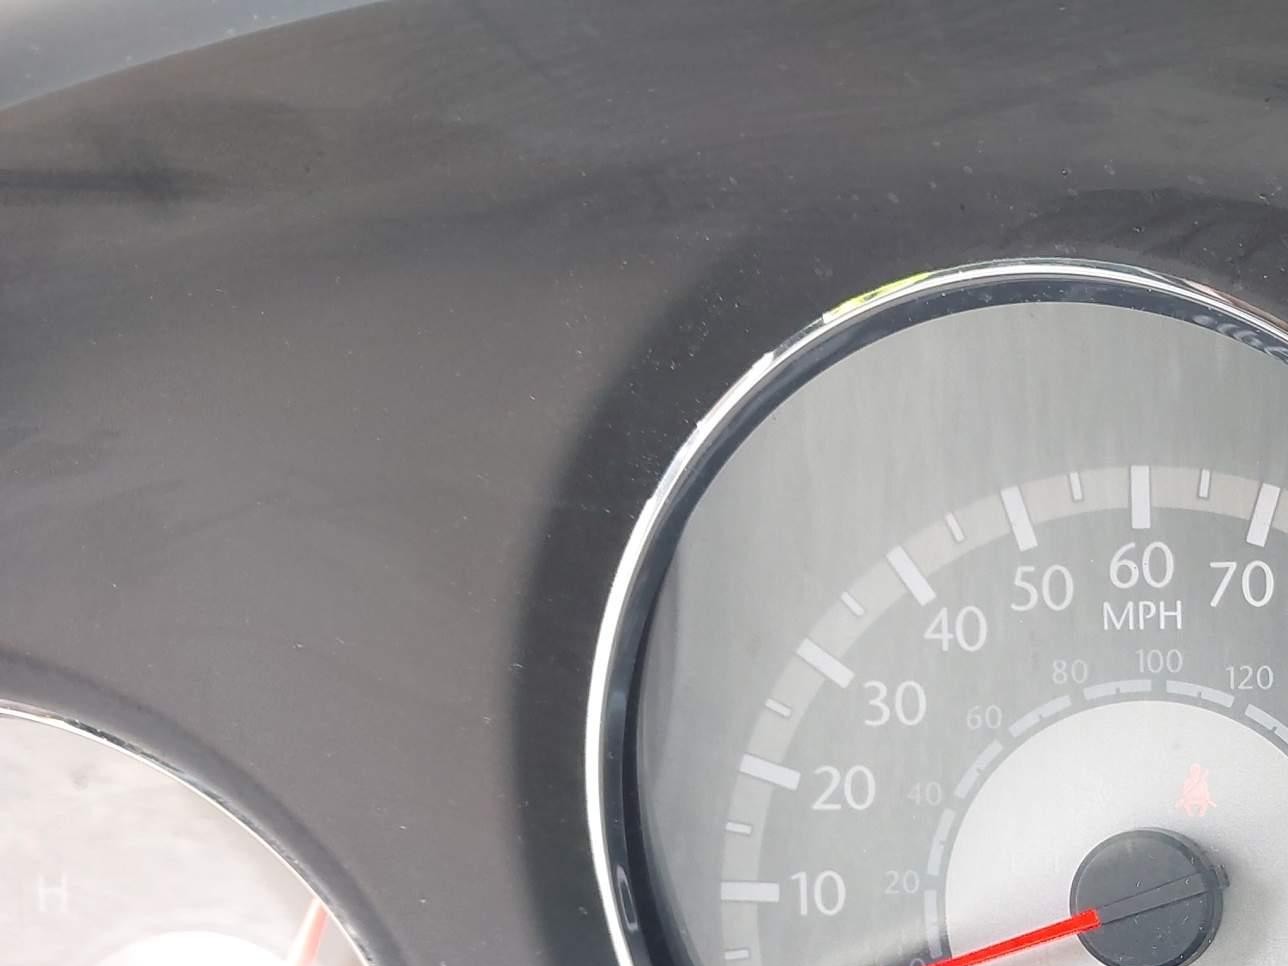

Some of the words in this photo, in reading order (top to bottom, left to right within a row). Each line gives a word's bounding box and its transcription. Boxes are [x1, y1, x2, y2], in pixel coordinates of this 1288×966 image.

[1110, 542, 1174, 588] 60
[1210, 561, 1274, 607] 70
[1011, 565, 1073, 611] 50
[924, 606, 987, 651] 40
[1104, 601, 1182, 630] MPH
[1052, 660, 1087, 684] 80
[1138, 649, 1183, 673] 100
[1227, 666, 1273, 690] 120
[864, 681, 927, 726] 30
[967, 705, 1002, 730] 60
[812, 766, 876, 810] 20
[908, 782, 943, 805] 40
[38, 874, 68, 912] H
[791, 871, 846, 916] 10
[885, 870, 920, 894] 20
